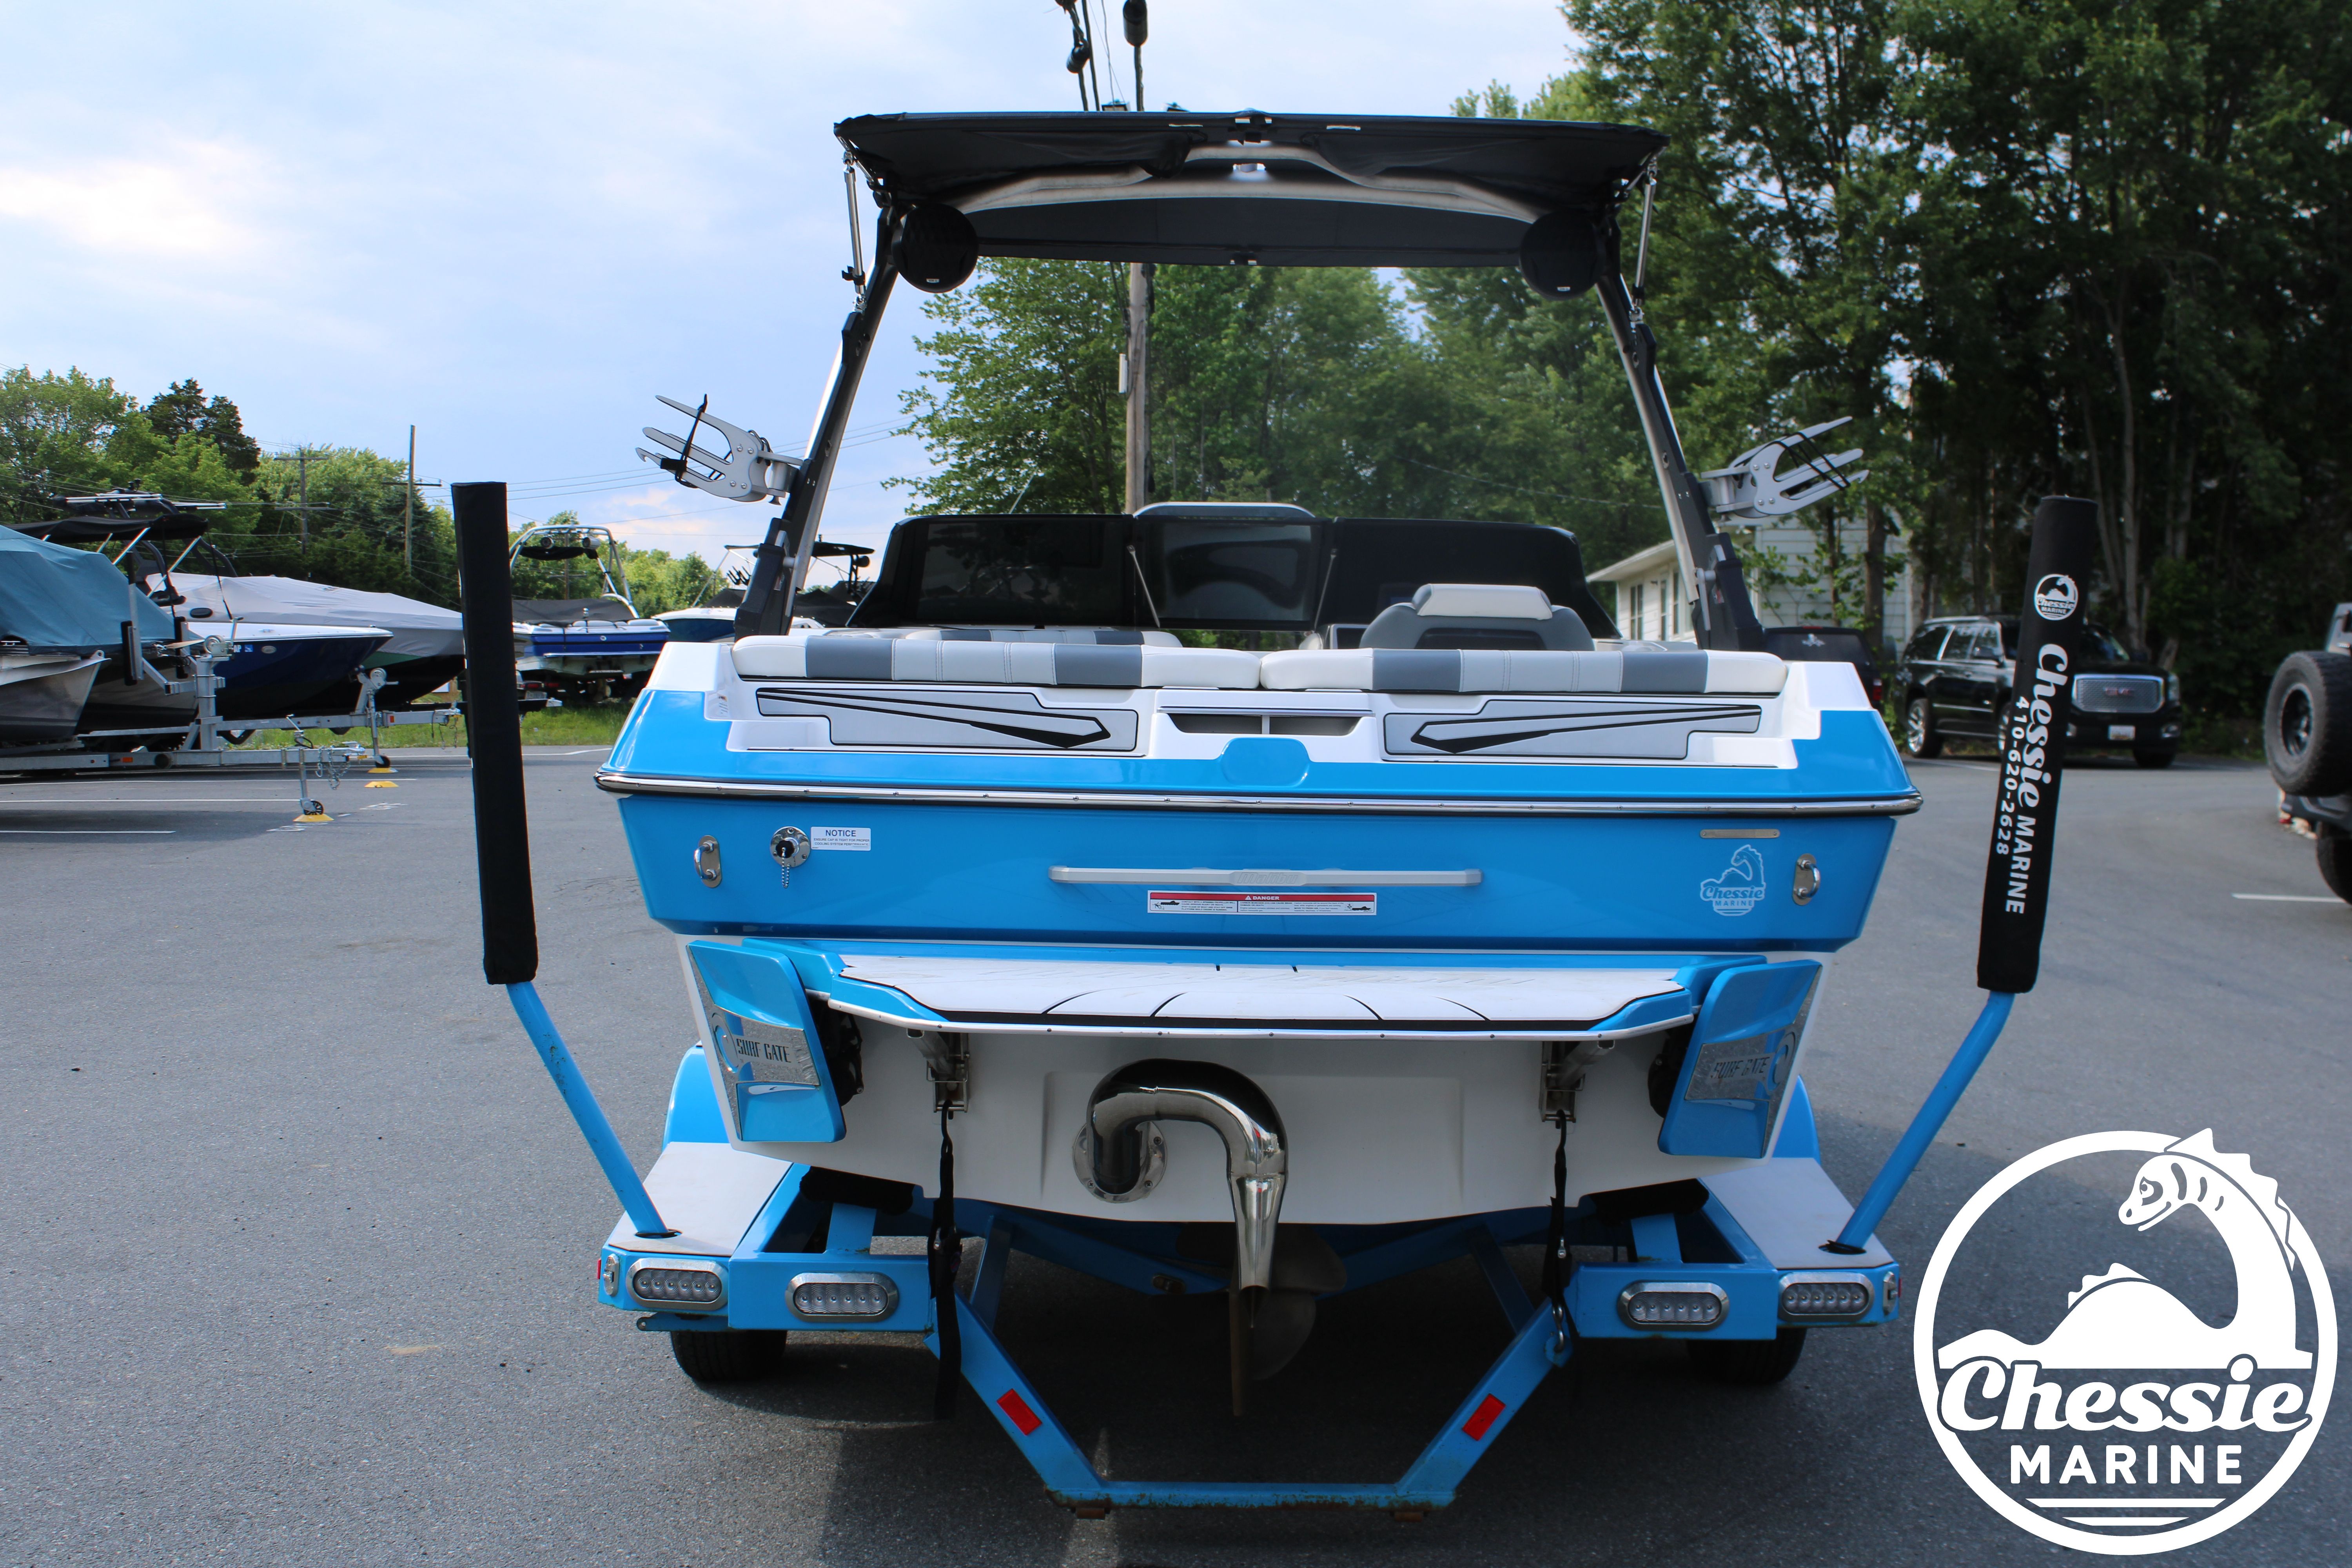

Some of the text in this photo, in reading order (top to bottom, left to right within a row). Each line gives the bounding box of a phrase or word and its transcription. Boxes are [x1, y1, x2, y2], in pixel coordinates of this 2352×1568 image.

[1996, 696, 2030, 855] 410-620-2628
[2005, 644, 2068, 914] Chessie MARINE
[1703, 886, 1763, 899] Chessie
[736, 1038, 792, 1063] SURF GATE
[1711, 1057, 1770, 1079] SURF GATE
